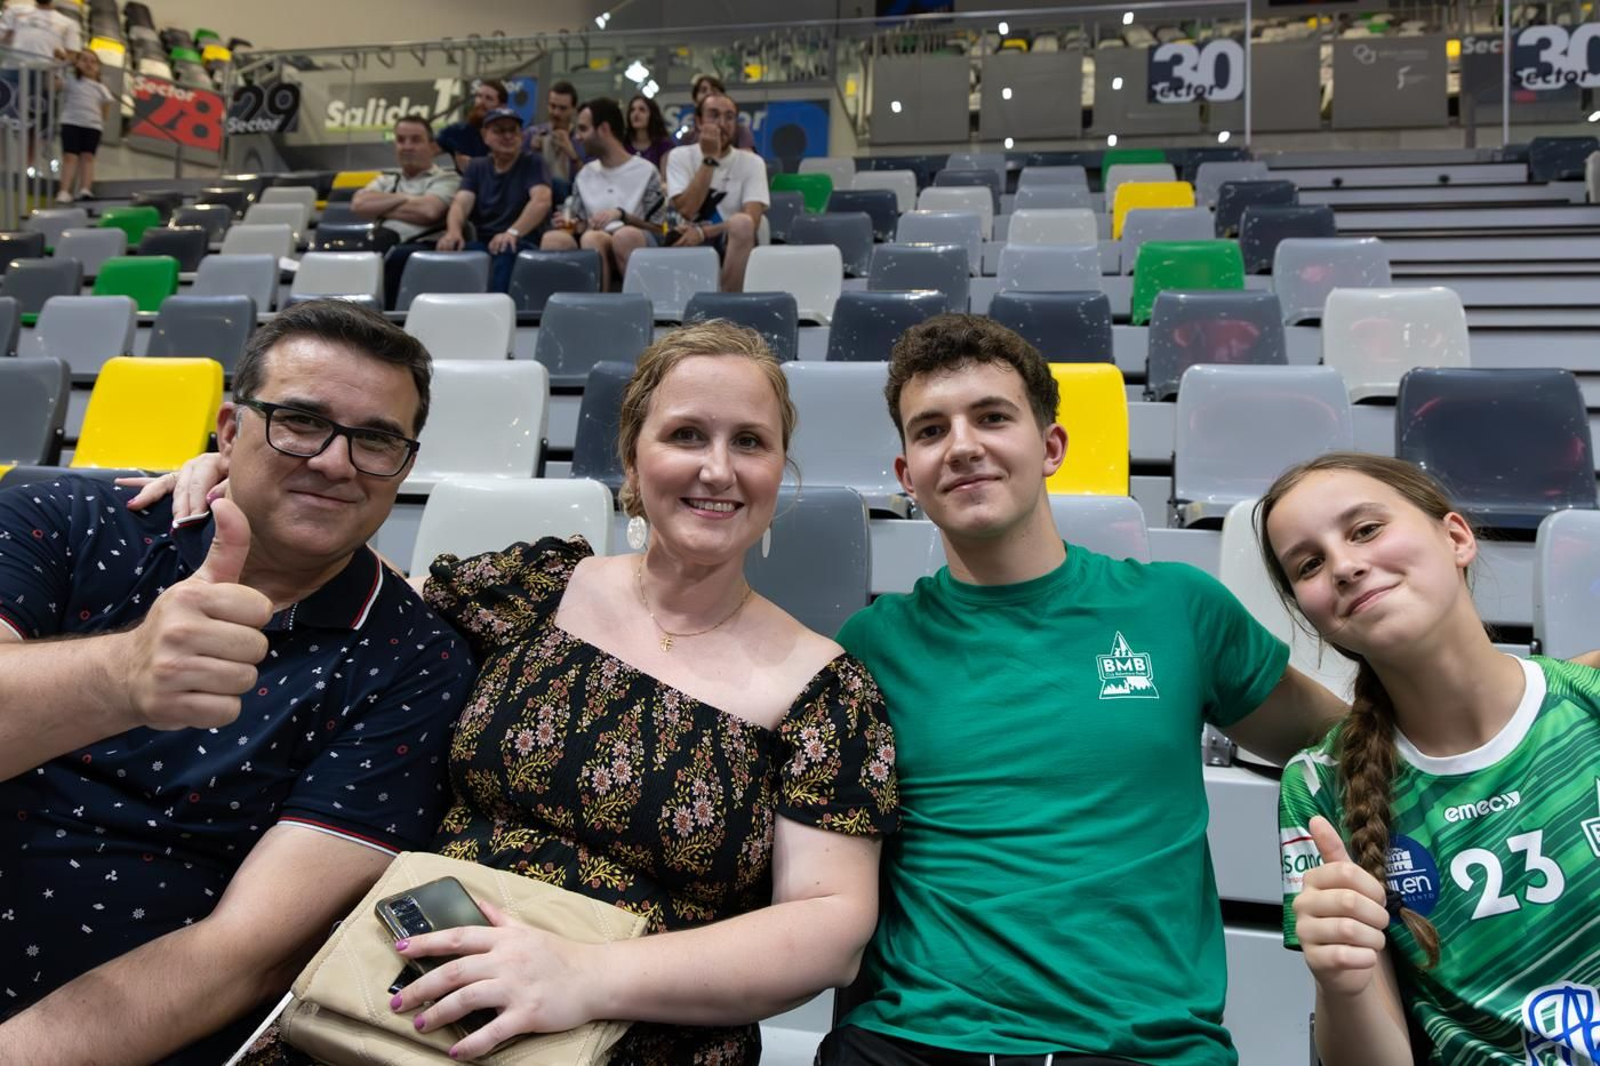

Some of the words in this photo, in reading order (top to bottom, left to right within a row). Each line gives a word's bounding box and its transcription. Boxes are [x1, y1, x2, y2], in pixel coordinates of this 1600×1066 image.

[131, 76, 196, 102] Sector
[1153, 39, 1244, 103] 30
[130, 80, 224, 151] 28
[227, 116, 281, 134] Sector
[230, 83, 300, 133] 29
[325, 97, 430, 127] Salida
[1102, 657, 1146, 673] BMB
[1450, 829, 1566, 921] 23
